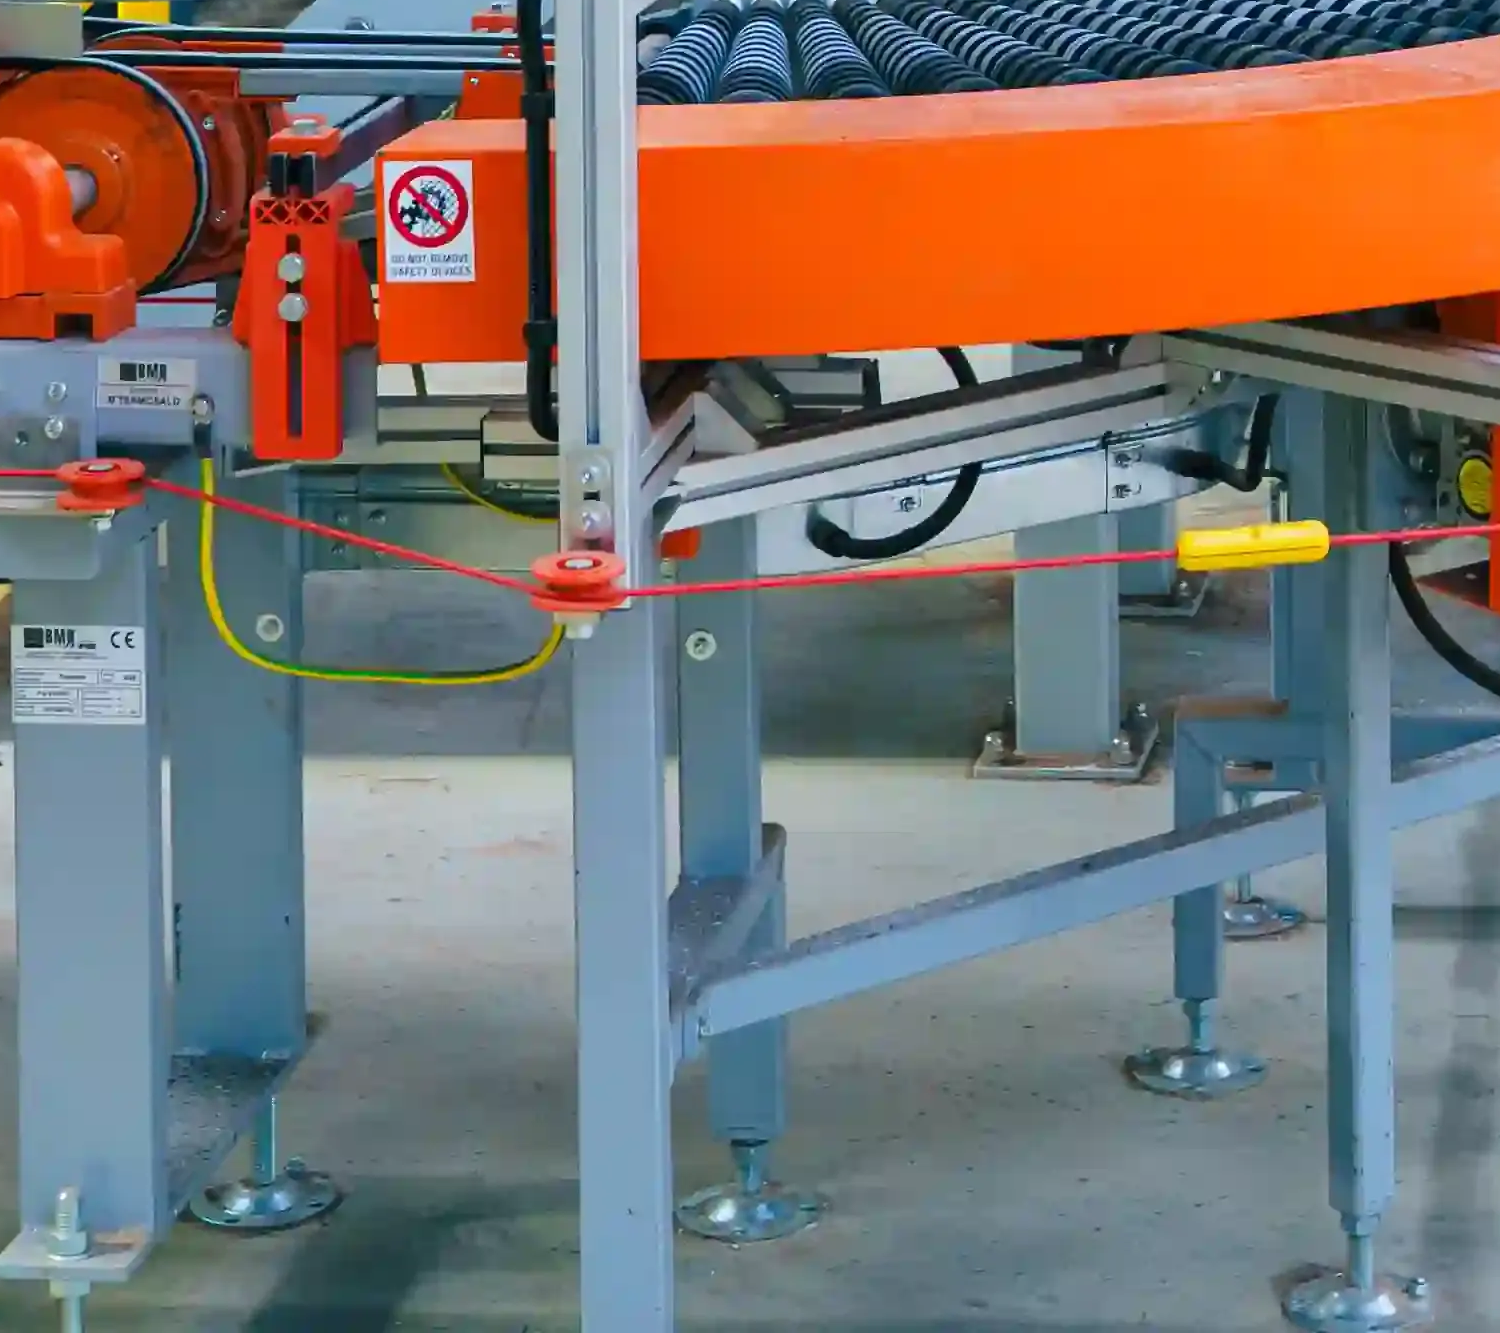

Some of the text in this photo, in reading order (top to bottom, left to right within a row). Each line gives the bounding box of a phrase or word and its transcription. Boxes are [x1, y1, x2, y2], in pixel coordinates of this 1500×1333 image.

[408, 253, 427, 263] NOT
[430, 253, 468, 263] REMOVE
[391, 266, 472, 277] SAFETY DEVICES
